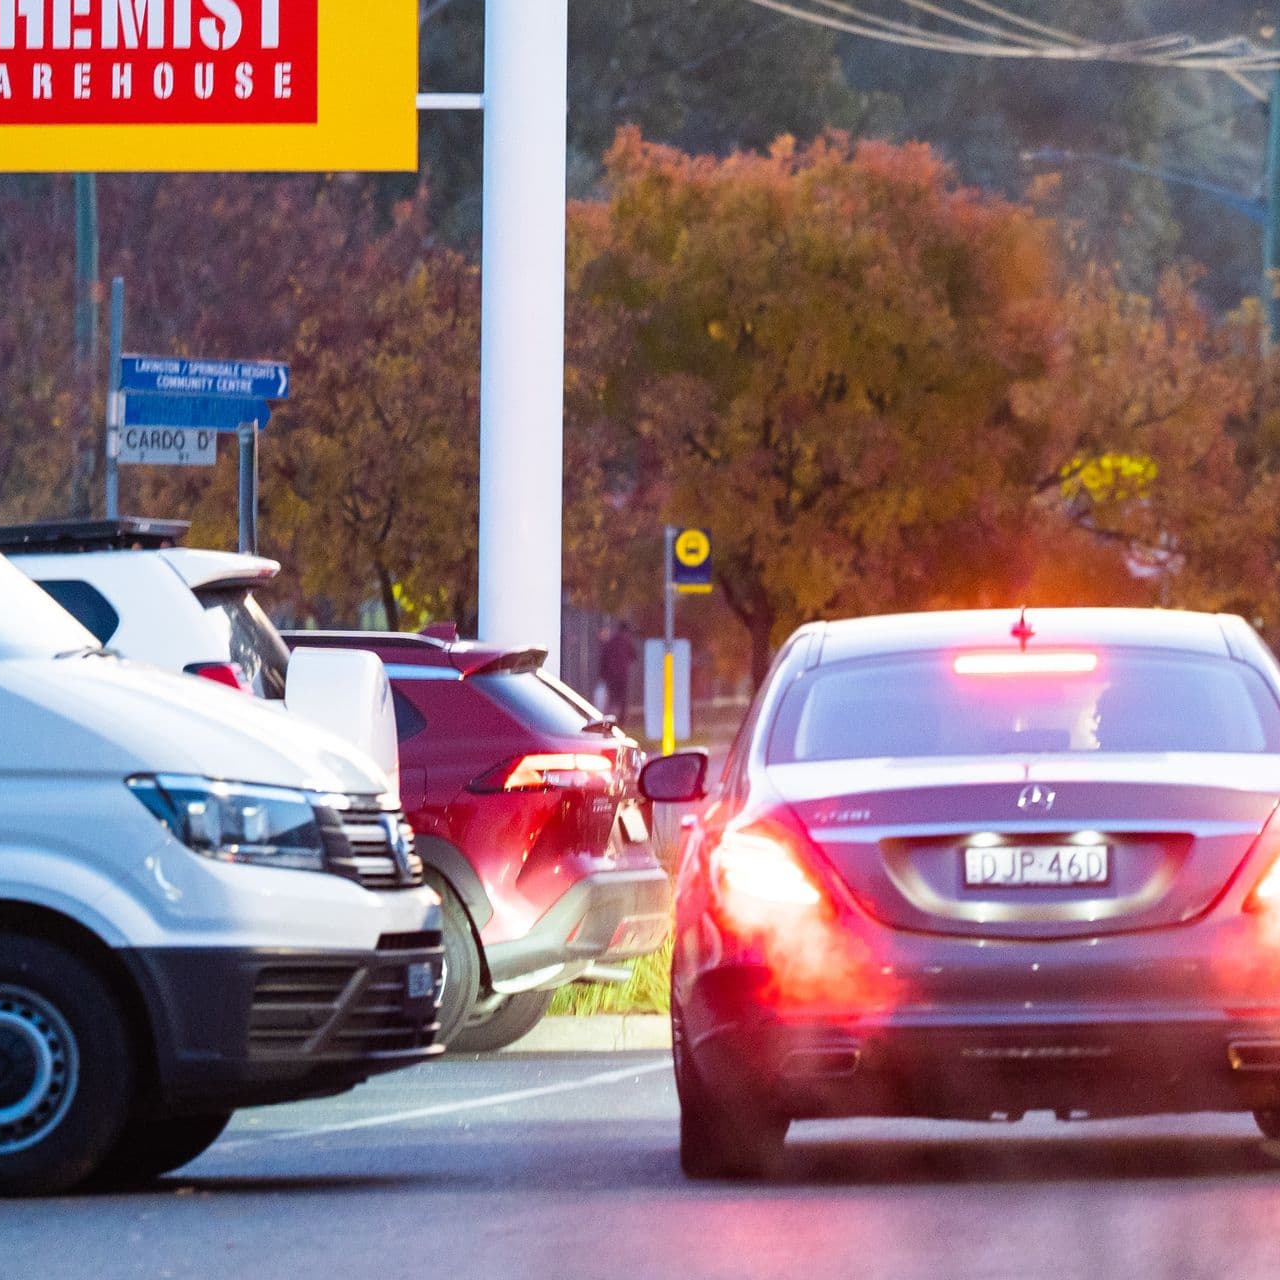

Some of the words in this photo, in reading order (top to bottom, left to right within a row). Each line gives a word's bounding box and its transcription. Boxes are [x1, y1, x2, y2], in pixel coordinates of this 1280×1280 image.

[156, 374, 214, 391] COMMUNITY
[216, 377, 253, 394] CENTRE
[126, 428, 186, 451] CARDO
